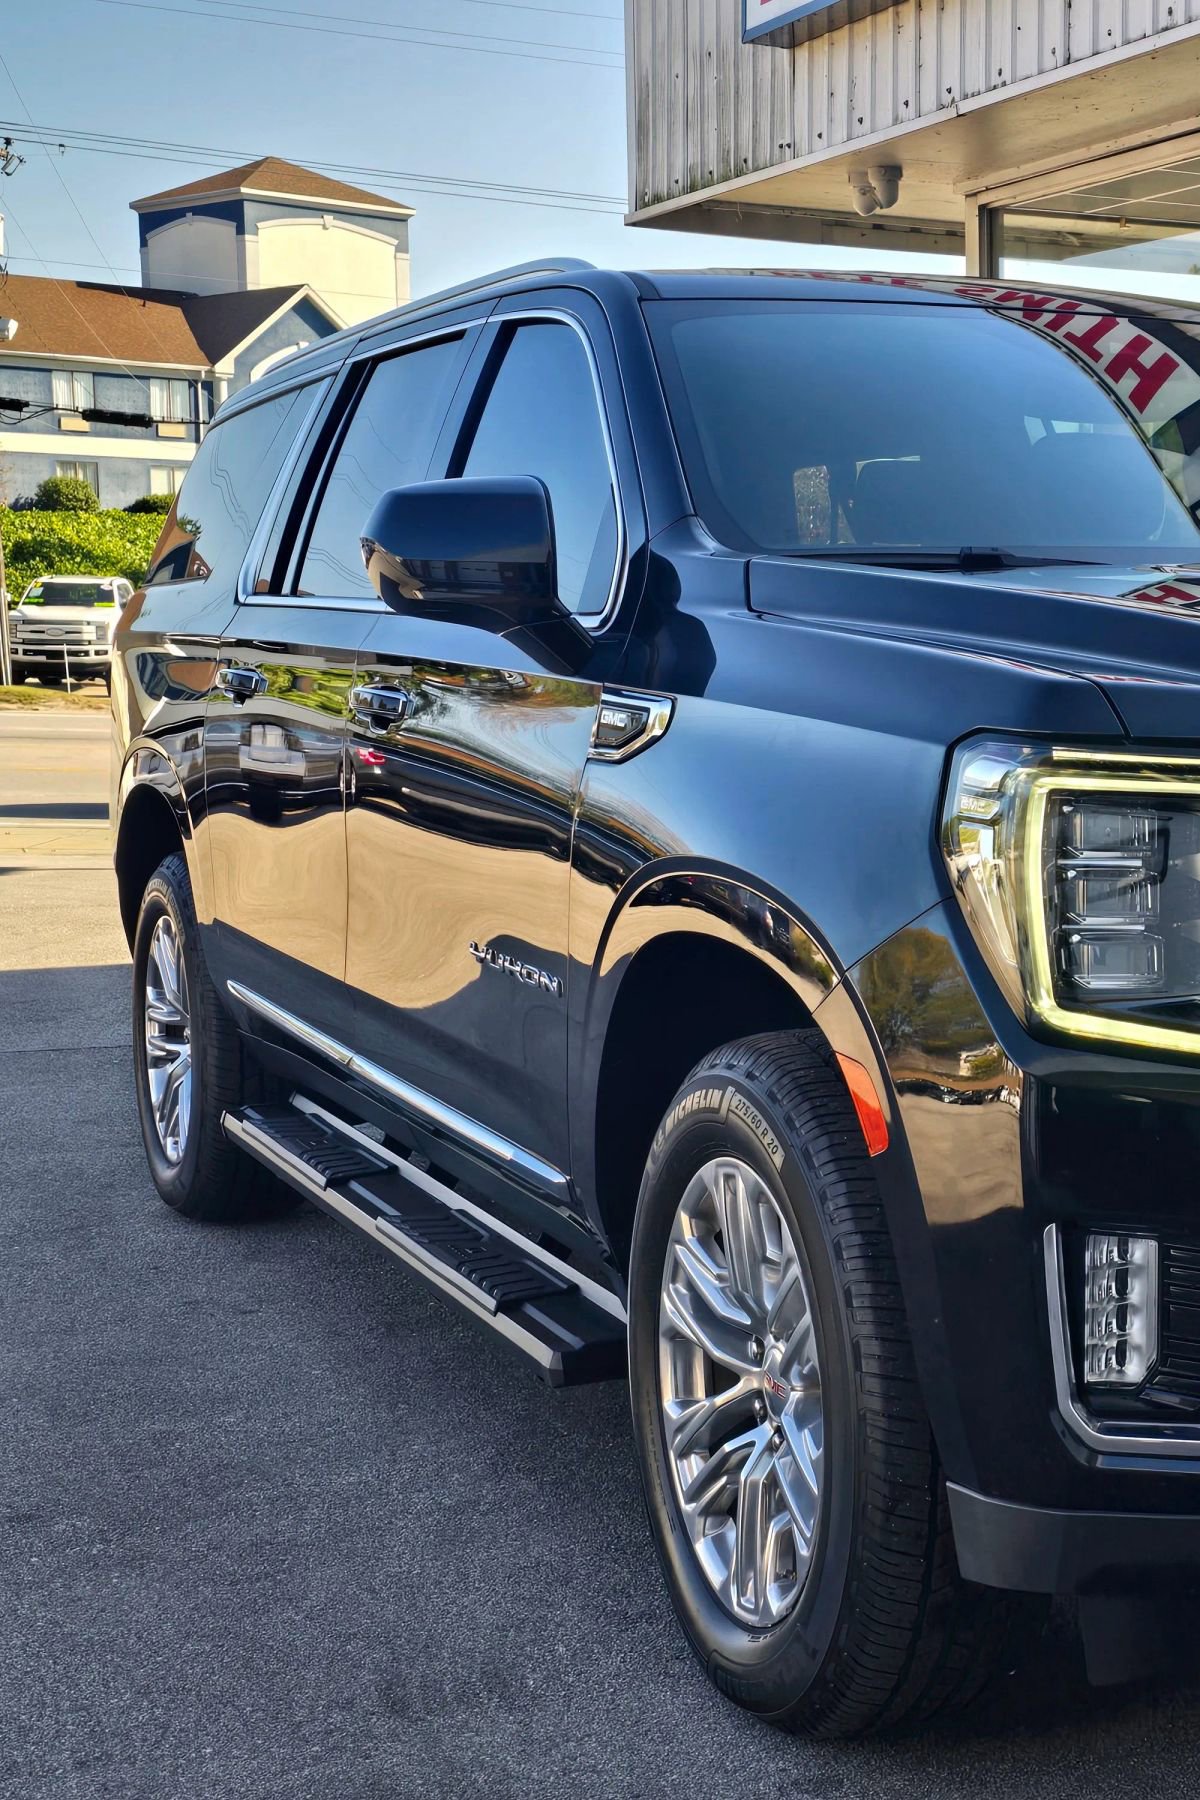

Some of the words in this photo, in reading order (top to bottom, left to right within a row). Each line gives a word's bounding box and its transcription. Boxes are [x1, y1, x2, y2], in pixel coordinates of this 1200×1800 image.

[600, 710, 628, 727] GMC
[468, 940, 564, 996] YUKON
[665, 1088, 723, 1137] MICHELIN
[735, 1099, 762, 1130] 275/60
[760, 1127, 769, 1139] R
[767, 1138, 779, 1155] 20
